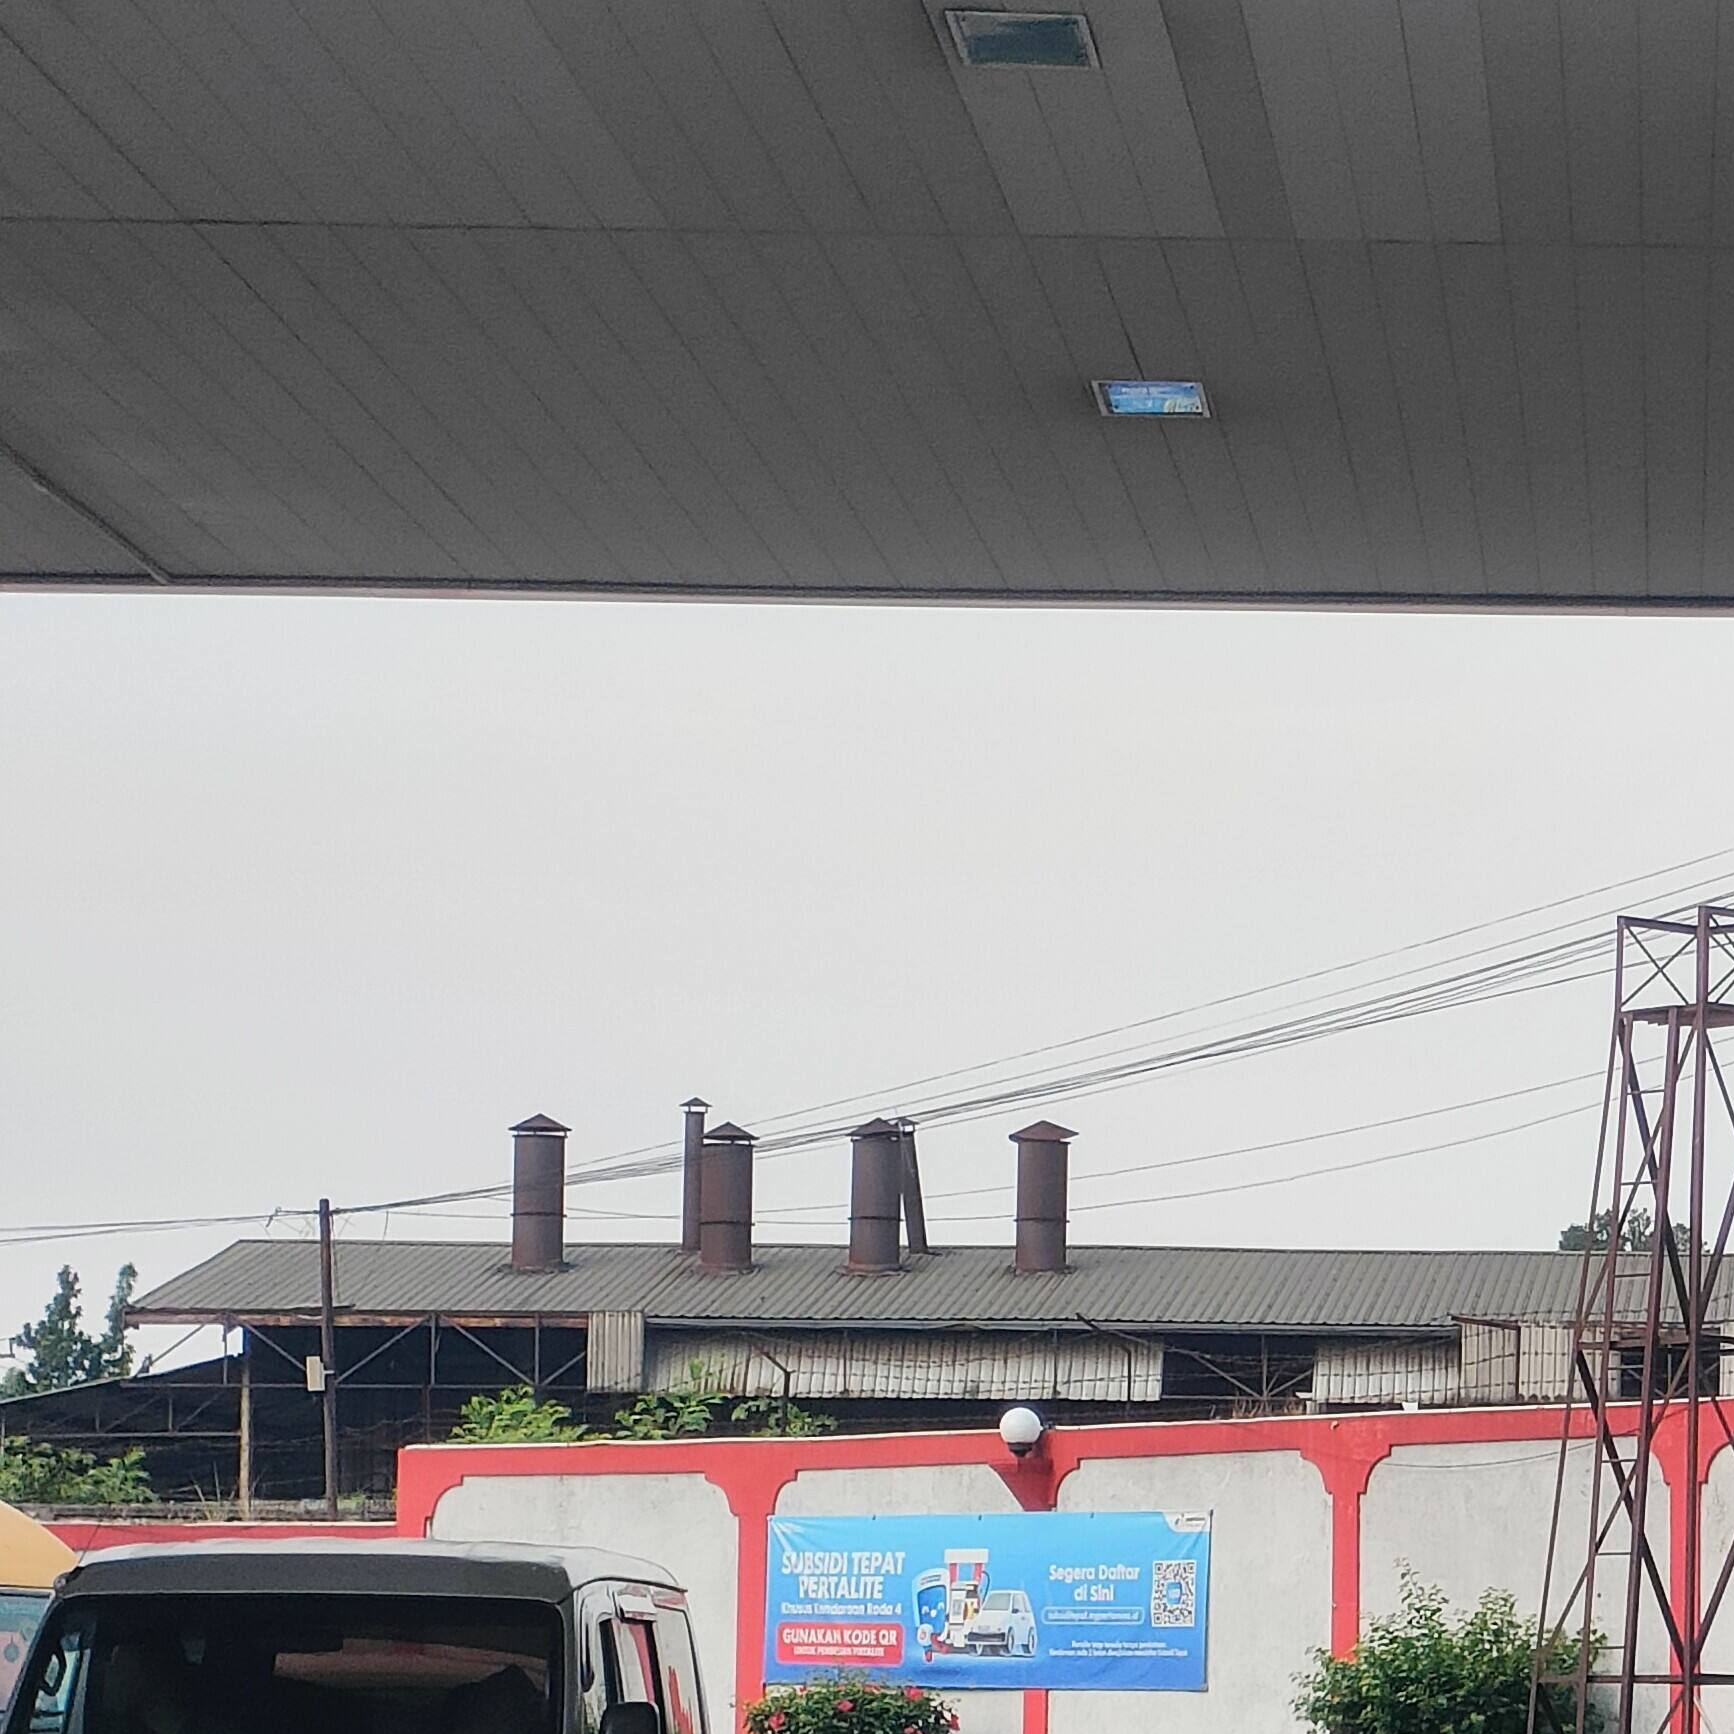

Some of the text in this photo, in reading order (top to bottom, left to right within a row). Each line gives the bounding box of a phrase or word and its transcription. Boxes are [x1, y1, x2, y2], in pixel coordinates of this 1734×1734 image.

[781, 1551, 906, 1575] SUBSIDI TEPAT
[1049, 1564, 1140, 1583] Segera Daftar
[798, 1575, 884, 1599] PERTALITE
[1074, 1583, 1114, 1601] di Sini
[895, 1603, 902, 1615] 4
[782, 1628, 897, 1645] GUNAKAN KODE QR
